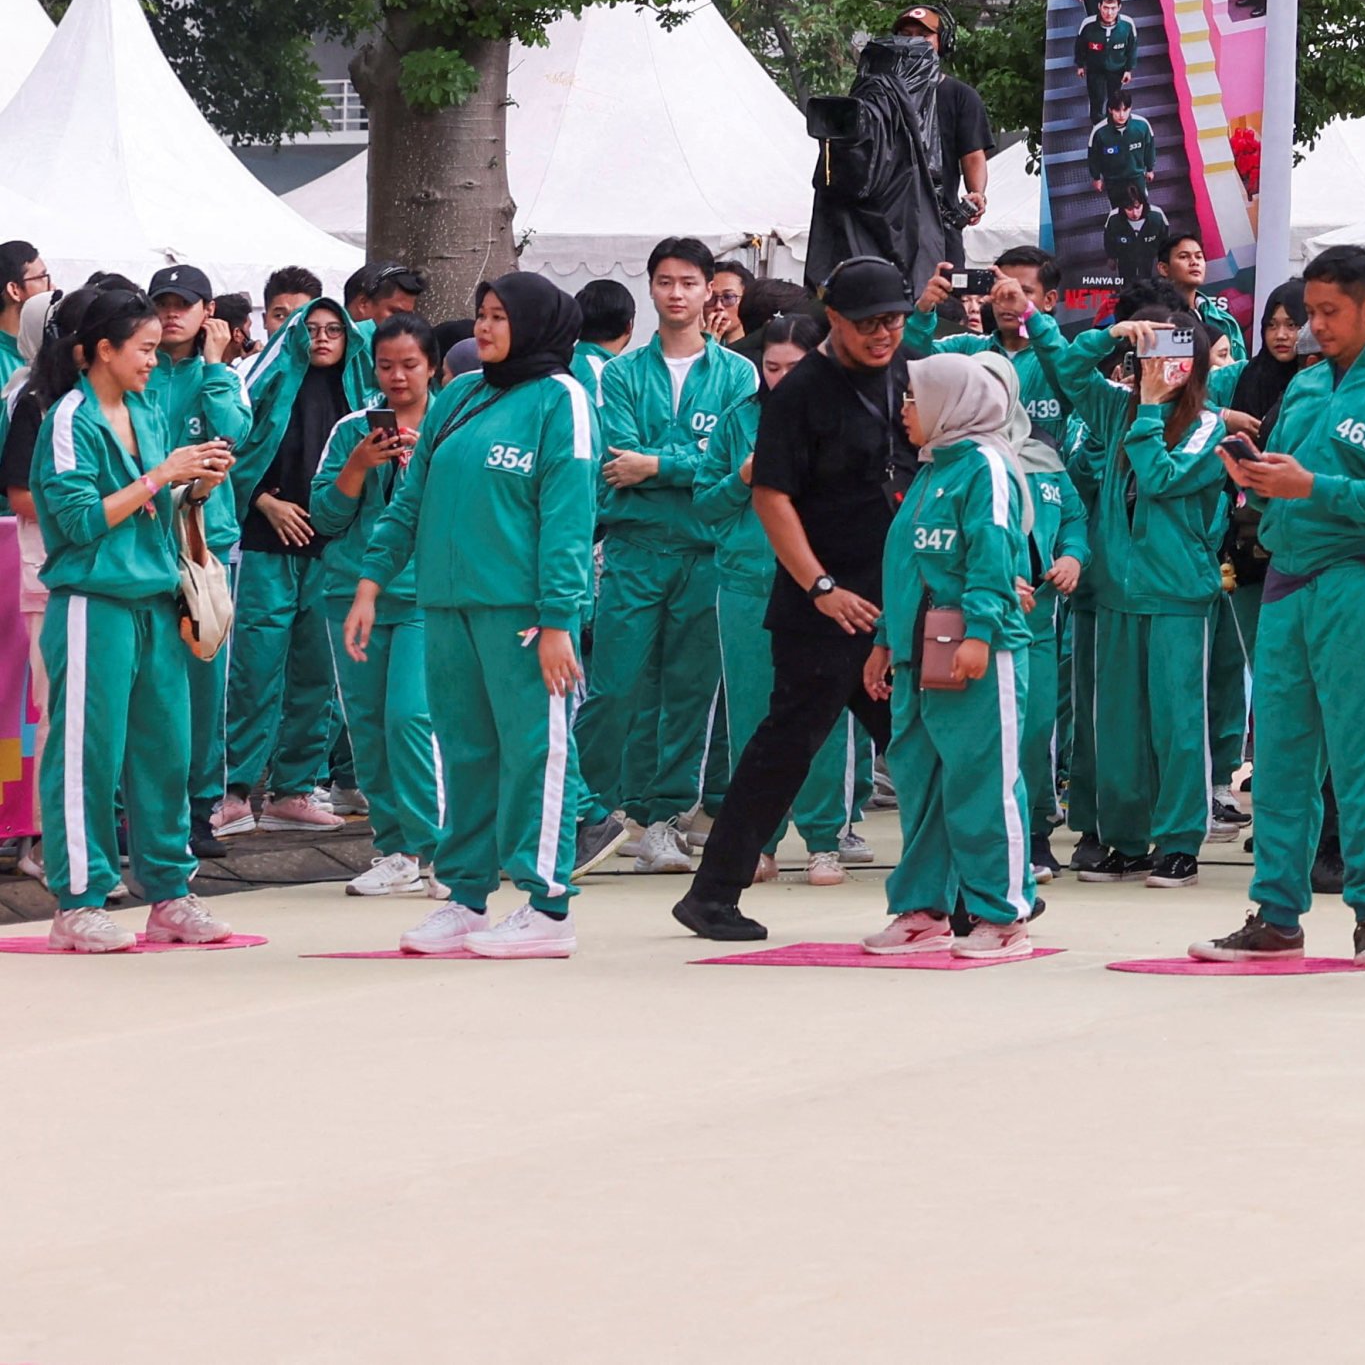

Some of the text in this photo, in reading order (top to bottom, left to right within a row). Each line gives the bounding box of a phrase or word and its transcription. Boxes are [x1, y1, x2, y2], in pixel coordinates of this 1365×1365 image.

[1082, 276, 1124, 285] HANYA DI
[1026, 398, 1061, 418] 439
[691, 412, 719, 433] 02
[487, 444, 533, 473] 354
[913, 527, 957, 551] 347
